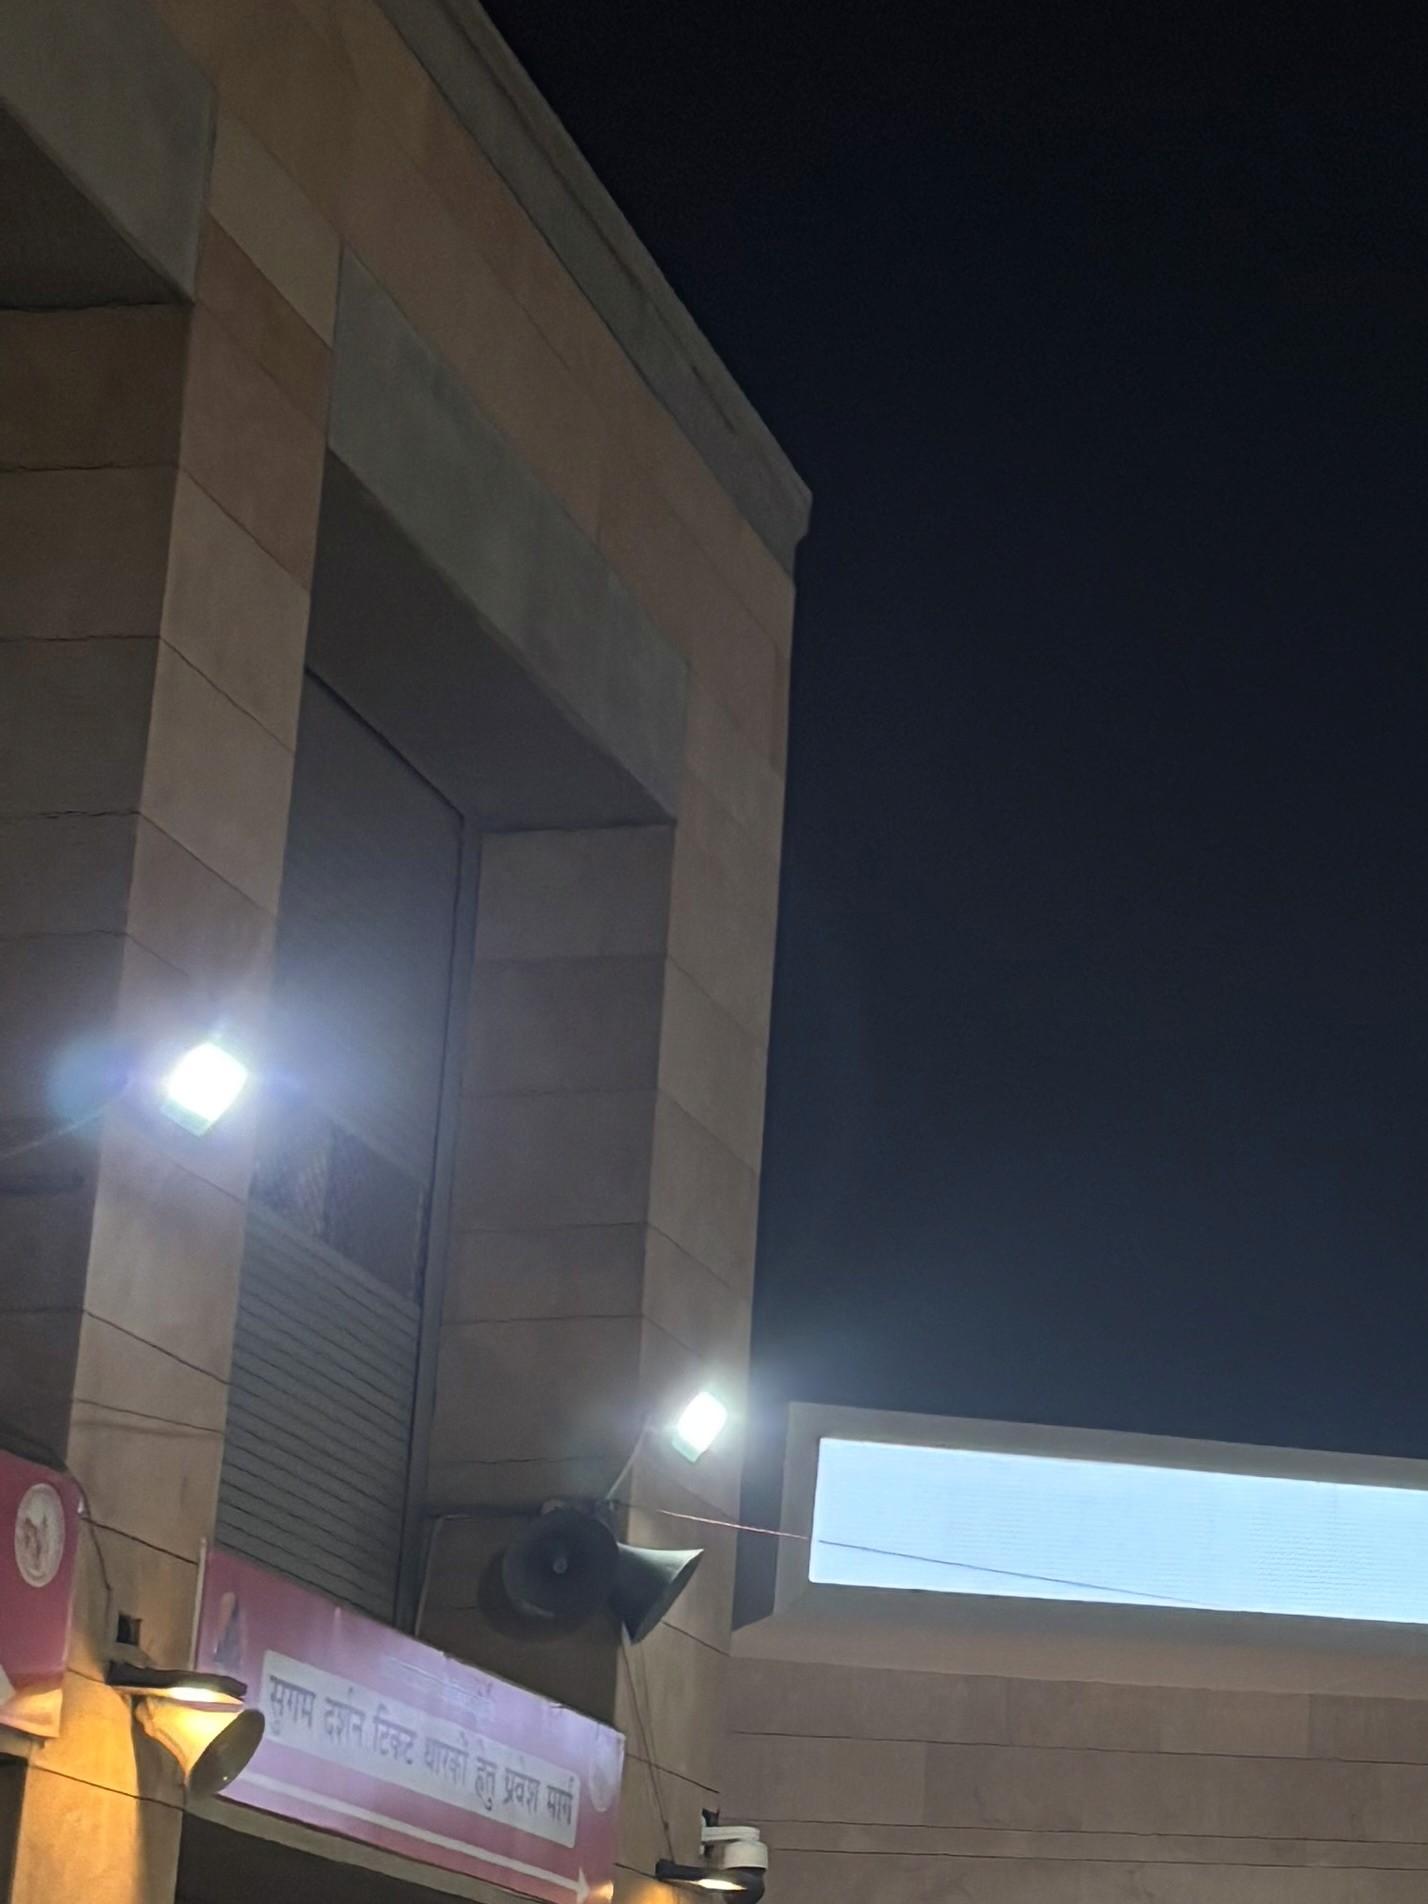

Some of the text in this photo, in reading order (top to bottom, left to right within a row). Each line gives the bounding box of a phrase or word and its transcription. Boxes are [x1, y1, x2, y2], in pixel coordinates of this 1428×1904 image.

[269, 1674, 317, 1736] सुगम
[324, 1686, 366, 1747] दर्शन
[373, 1702, 417, 1765] टिकट
[474, 1738, 498, 1811] हेतु
[503, 1756, 541, 1814] प्रवेश
[546, 1775, 575, 1825] मार्ग
